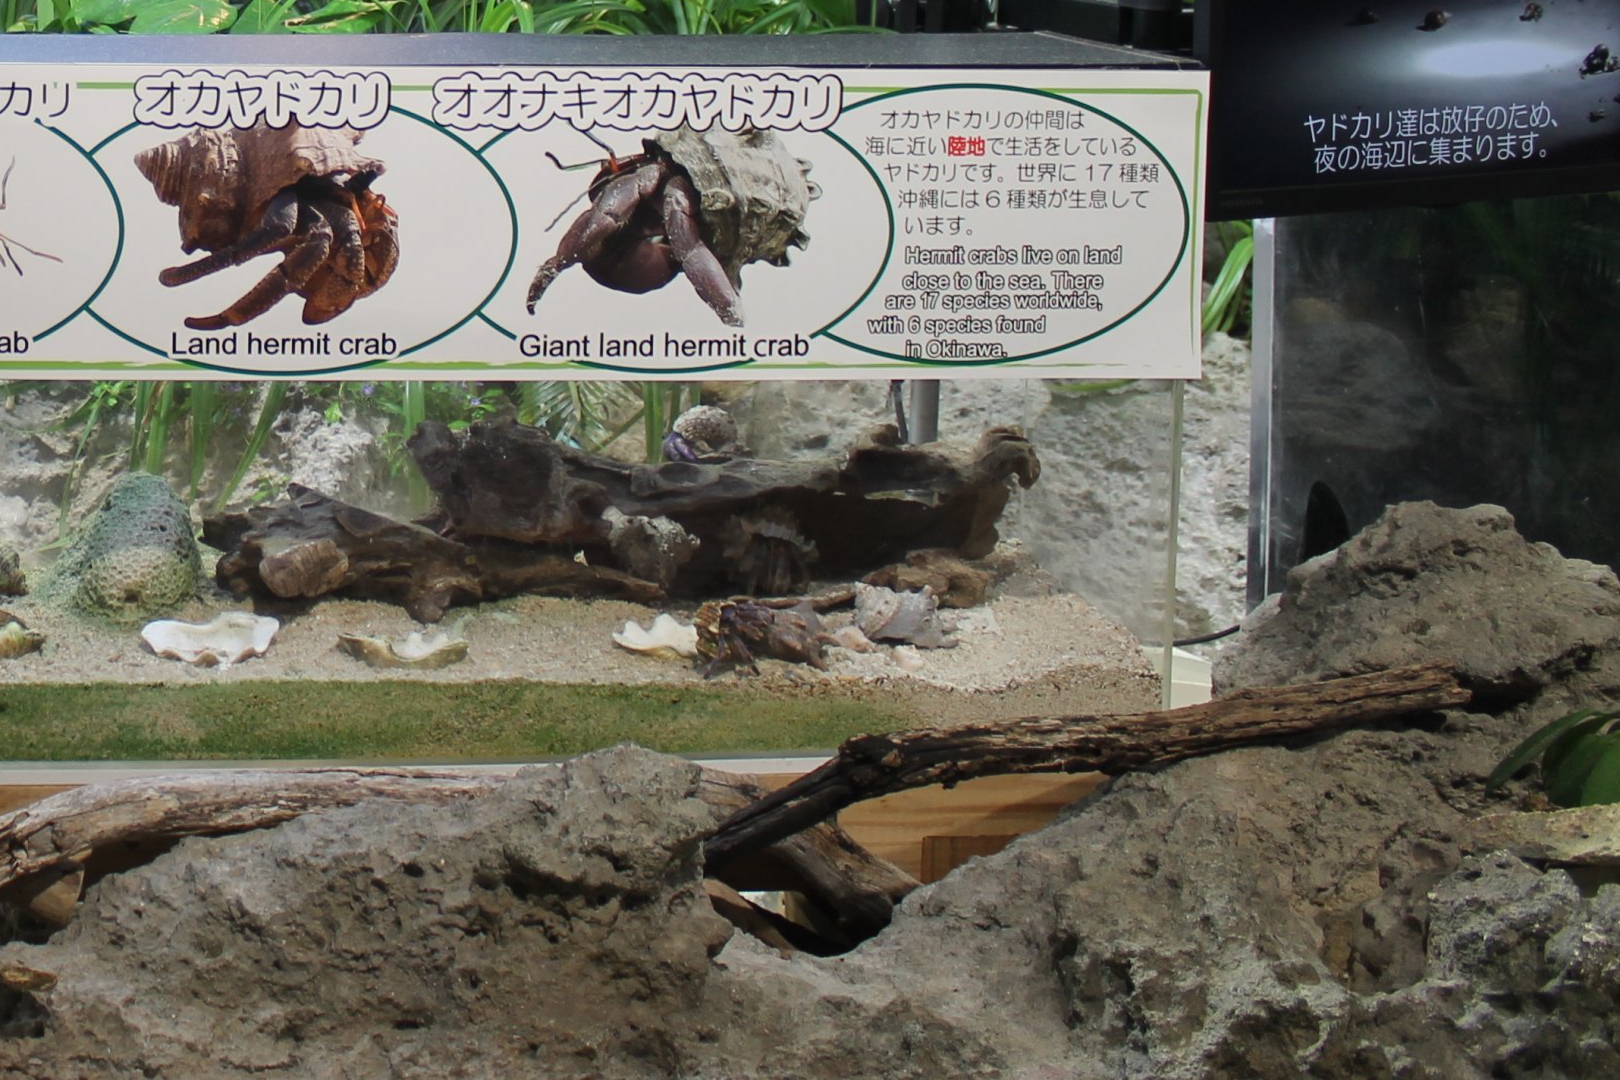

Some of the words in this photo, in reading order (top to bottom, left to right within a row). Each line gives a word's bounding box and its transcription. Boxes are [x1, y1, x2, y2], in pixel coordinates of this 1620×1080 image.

[144, 80, 381, 119] オカヤドカリ
[442, 81, 837, 122] オオナキオカヤドカリ
[880, 110, 1085, 130] オカヤドカリの仲間は
[1304, 101, 1558, 144] ヤドカリ達は放仔のため、
[1314, 131, 1549, 175] 夜の海辺に集まります。
[905, 216, 973, 236] います。
[905, 245, 965, 265] Hermit
[967, 245, 1018, 265] crabs
[1022, 245, 1052, 265] live
[1055, 249, 1080, 265] on
[1083, 245, 1122, 265] land
[902, 271, 950, 290] close
[953, 273, 972, 290] to
[975, 271, 1004, 290] the
[1008, 274, 1046, 290] sea.
[1051, 270, 1104, 291] There
[884, 294, 916, 310] are
[920, 291, 940, 310] 17
[942, 291, 1010, 313] species
[1014, 290, 1103, 311] worldwide,
[867, 315, 904, 334] with
[907, 316, 921, 334] 6
[924, 315, 992, 337] species
[995, 315, 1046, 334] found
[172, 332, 239, 356] Land
[247, 331, 334, 356] hermit
[340, 331, 397, 356] crab
[518, 333, 591, 358] Giant
[598, 333, 658, 358] land
[664, 333, 748, 358] hermit
[753, 333, 810, 358] crab
[905, 339, 921, 358] in
[926, 340, 1008, 358] Okinawa.
